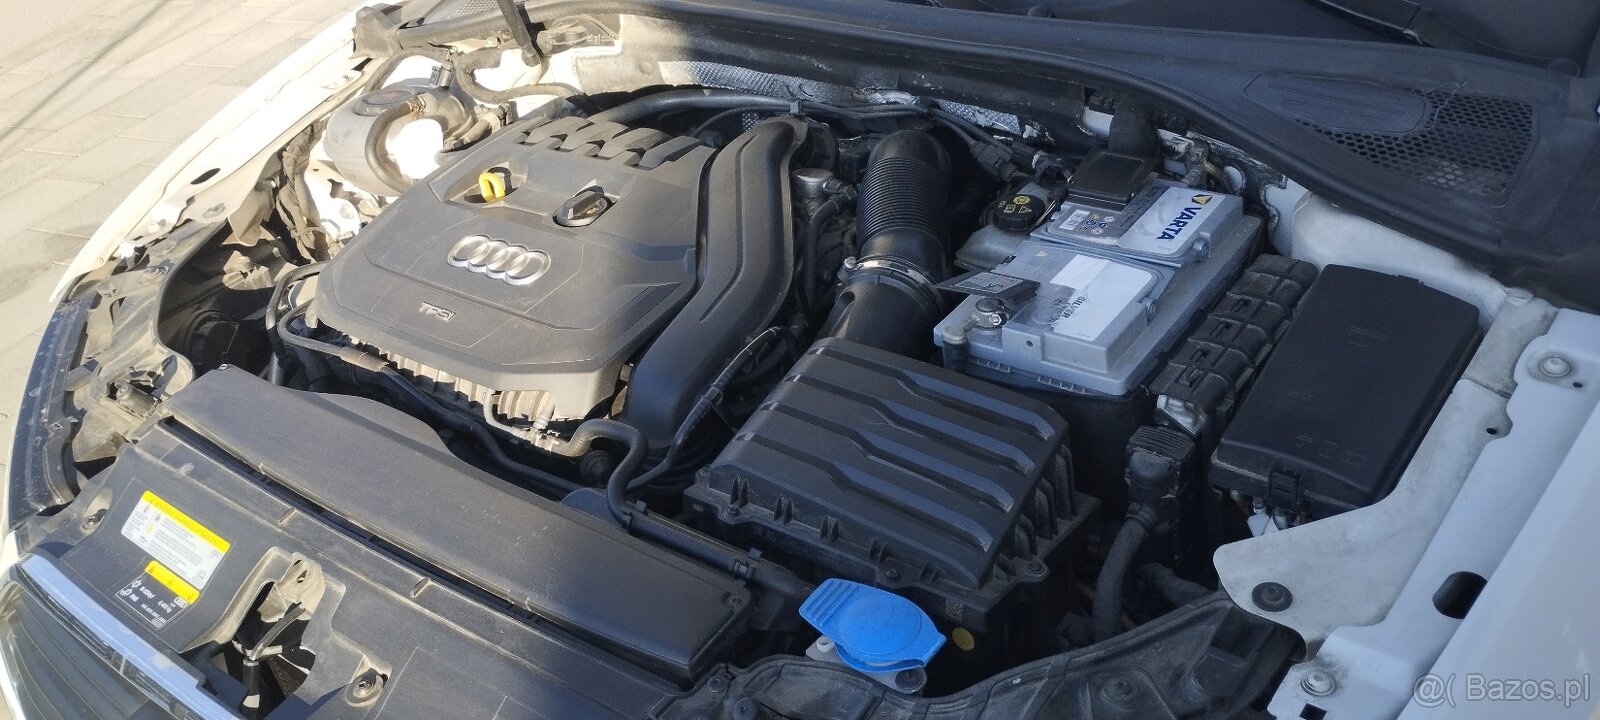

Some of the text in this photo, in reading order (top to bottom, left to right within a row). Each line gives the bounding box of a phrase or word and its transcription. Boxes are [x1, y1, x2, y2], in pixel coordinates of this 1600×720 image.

[1156, 207, 1202, 240] VARTA
[419, 301, 457, 322] TFSI
[1061, 295, 1087, 318] SILVER
